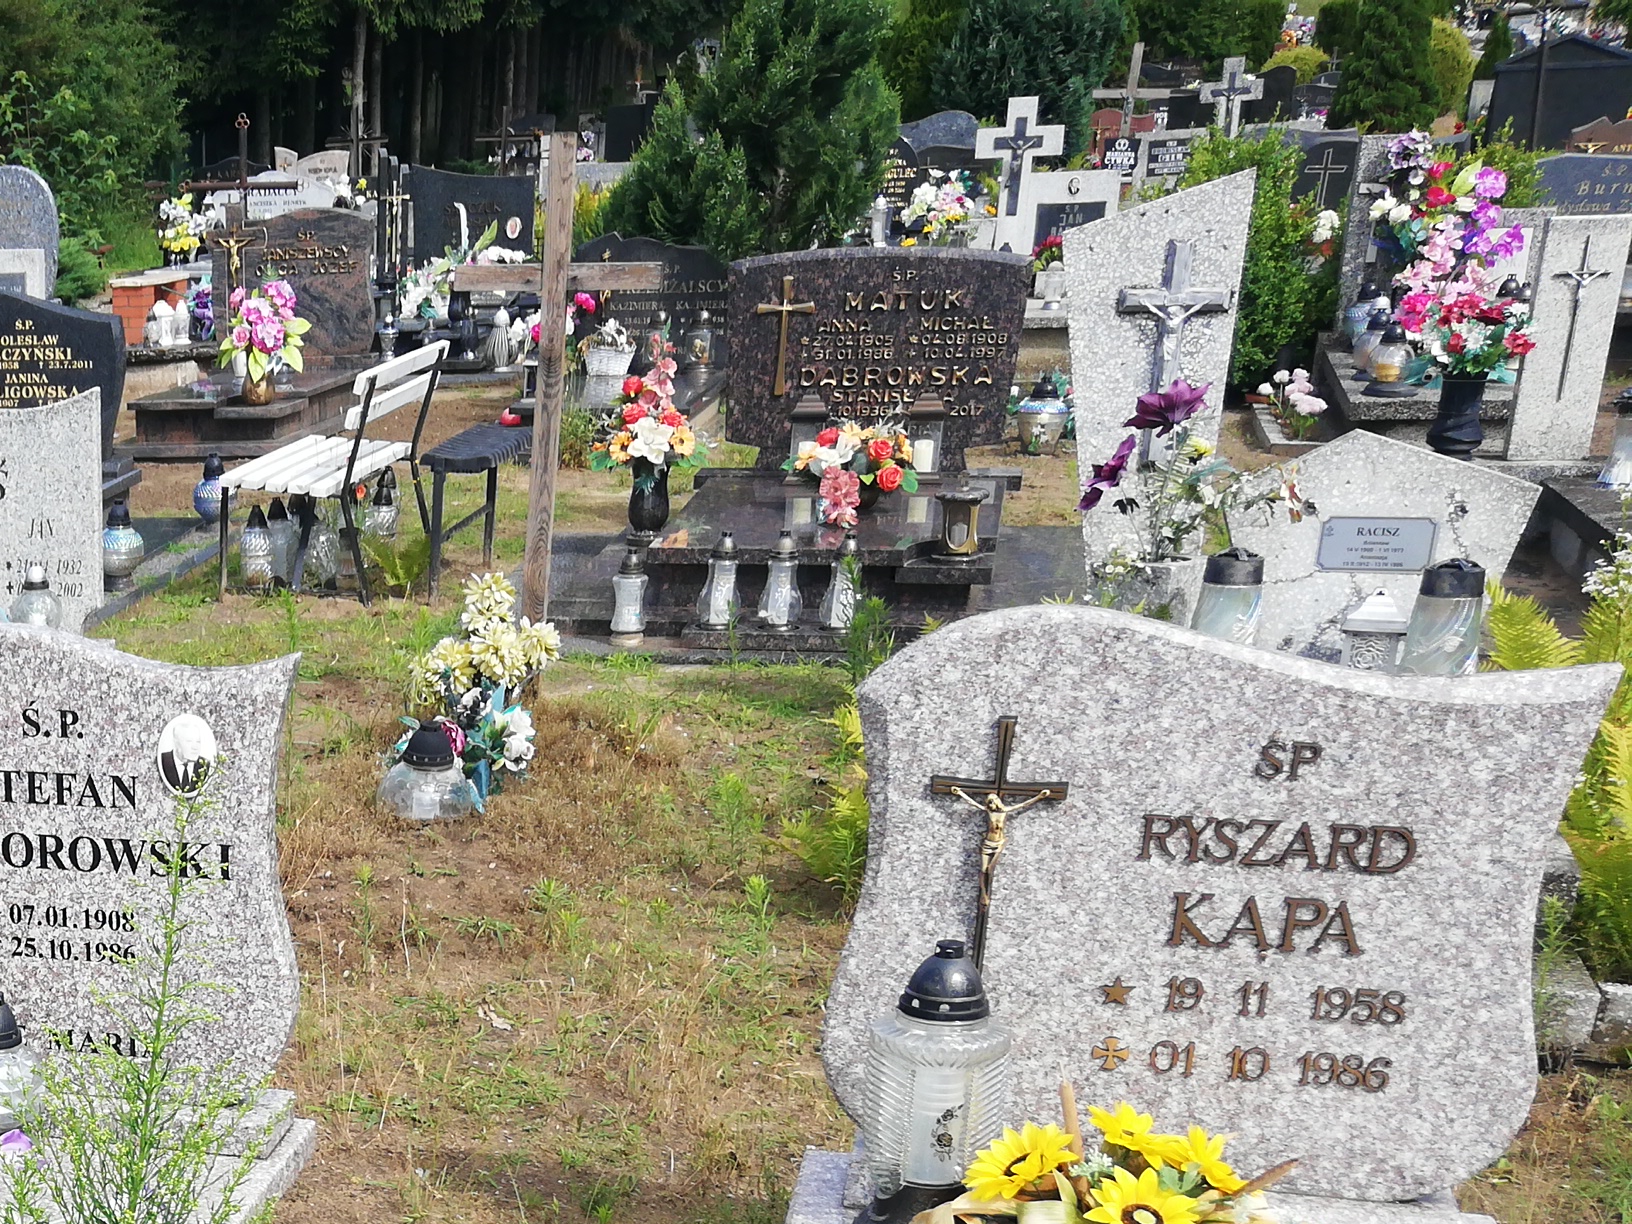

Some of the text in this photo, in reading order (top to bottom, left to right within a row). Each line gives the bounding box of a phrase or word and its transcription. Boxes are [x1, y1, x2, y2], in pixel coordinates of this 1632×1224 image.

[1104, 157, 1135, 165] CYWKA
[1058, 213, 1083, 226] JAN
[262, 244, 350, 261] JANISZEWSCY
[845, 289, 963, 312] MATUK
[818, 316, 995, 333] ANNA MICHAŁ
[921, 332, 1008, 346] 04.08.1908
[48, 360, 94, 369] 23.7.2011
[5, 373, 49, 384] JANINA
[27, 517, 56, 540] JAN
[1356, 526, 1400, 537] RACISZ
[56, 558, 83, 575] 1932
[56, 582, 84, 598] 2002
[21, 700, 85, 739] Ś.P.
[1137, 813, 1417, 875] RYSZARD
[8, 903, 136, 933] 07.01.1908
[1168, 891, 1365, 956] KAPA
[10, 935, 137, 965] 25.10.1986
[1164, 976, 1407, 1026] 19 11 1958
[1149, 1040, 1393, 1093] 01 10 1986
